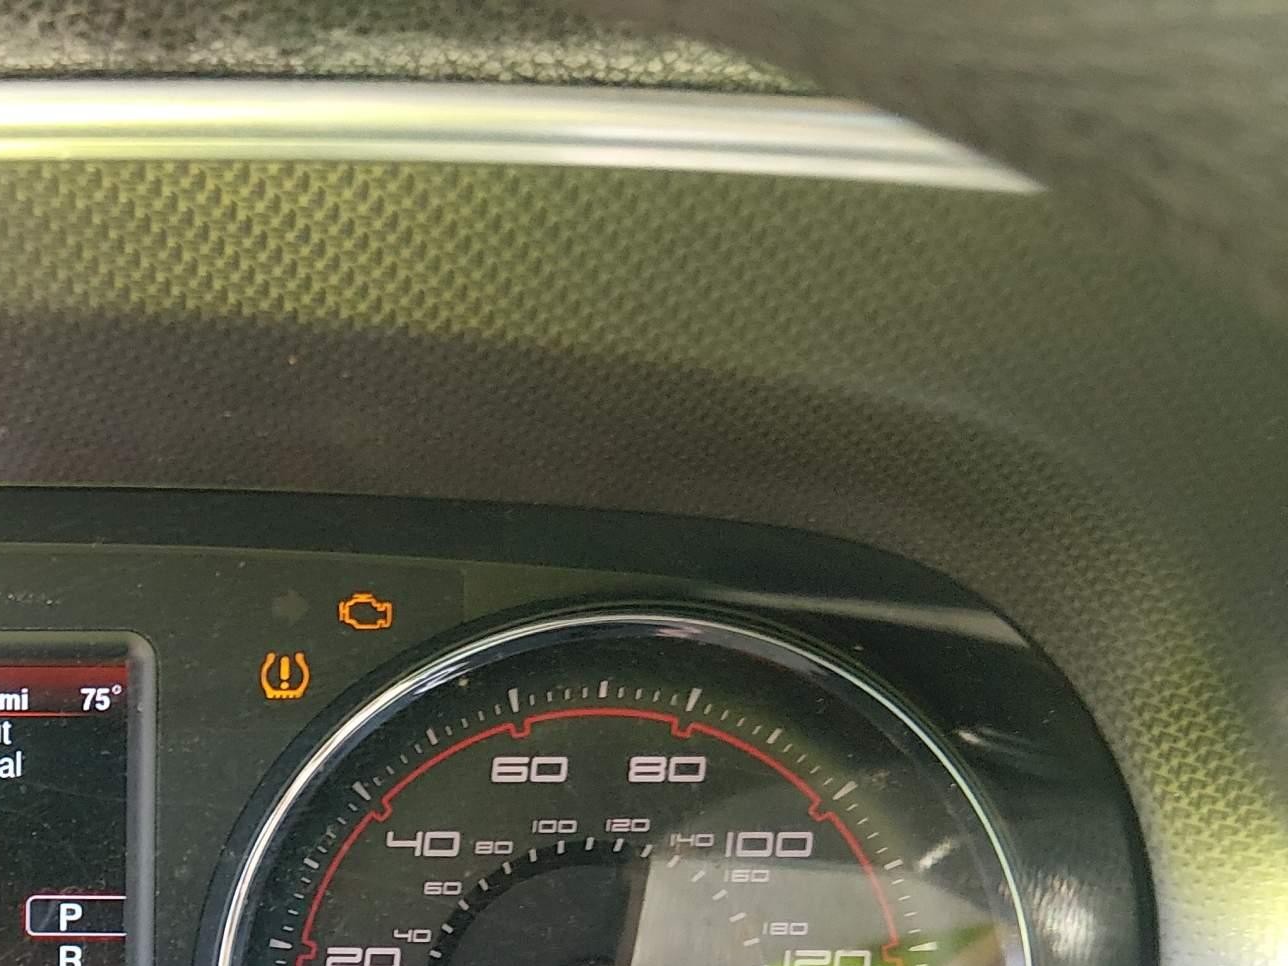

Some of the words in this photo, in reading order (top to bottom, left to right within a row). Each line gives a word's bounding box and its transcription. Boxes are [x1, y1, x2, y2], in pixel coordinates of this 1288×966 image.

[490, 757, 569, 783] 60
[627, 756, 707, 783] 80
[531, 820, 578, 834] 100
[604, 818, 651, 832] 120
[385, 831, 462, 858] 40
[669, 833, 715, 847] 140
[724, 831, 814, 858] 100
[474, 841, 514, 854] 80
[724, 869, 771, 883] 160
[423, 881, 462, 895] 60
[59, 903, 83, 931] P
[763, 922, 809, 935] 180
[393, 929, 432, 943] 40
